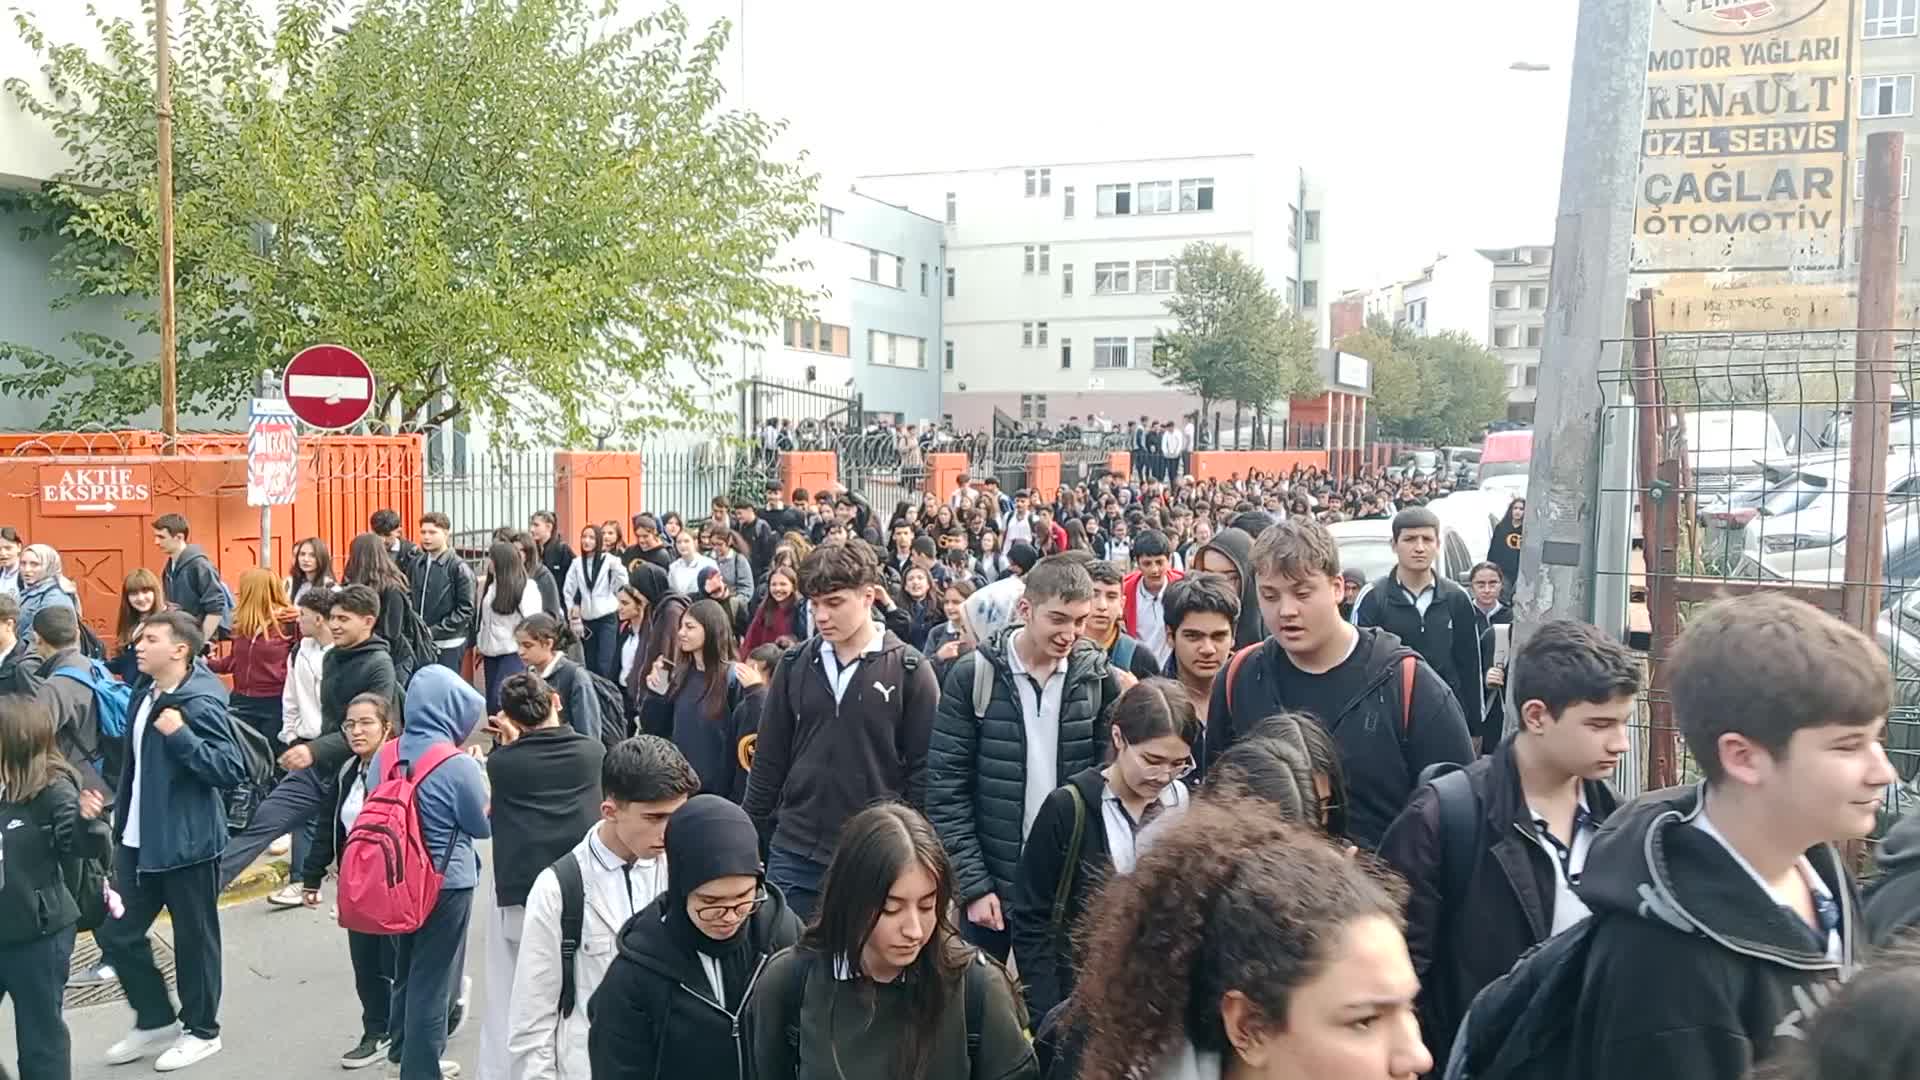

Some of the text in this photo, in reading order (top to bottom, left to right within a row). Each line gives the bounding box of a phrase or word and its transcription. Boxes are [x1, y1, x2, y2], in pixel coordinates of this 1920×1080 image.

[1648, 36, 1840, 73] MOTOR YAĞLARI
[1648, 74, 1838, 120] RENAULT
[1645, 122, 1837, 156] ÖZEL SERVİS
[1644, 162, 1834, 213] ÇAĞLAR
[1643, 204, 1833, 235] OTOMOTİV
[59, 465, 133, 485] AKTİF
[43, 484, 149, 502] EKSPRES
